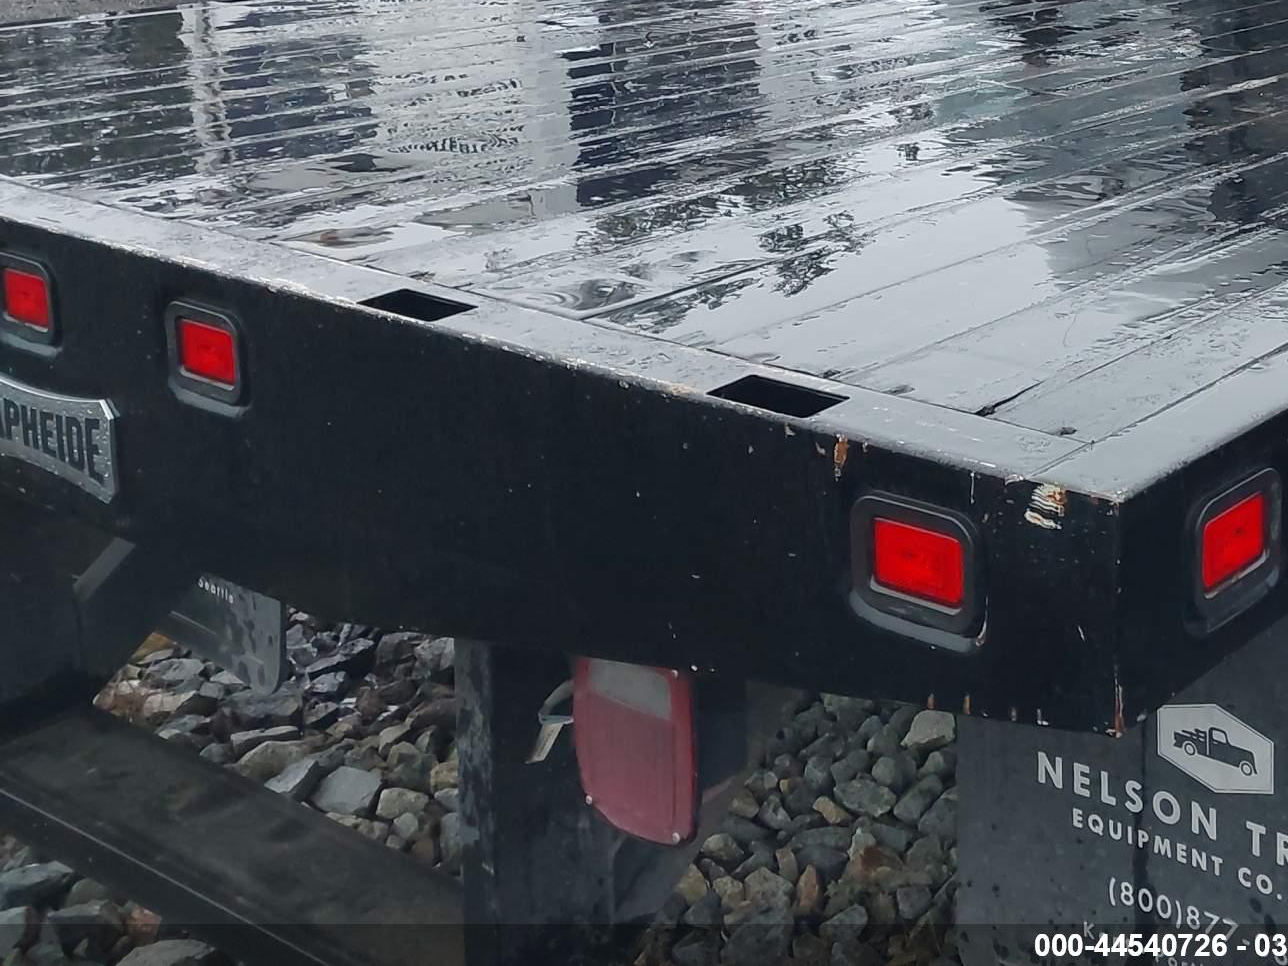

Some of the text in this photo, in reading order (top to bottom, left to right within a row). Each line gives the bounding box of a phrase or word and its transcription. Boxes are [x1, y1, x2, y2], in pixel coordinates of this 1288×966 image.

[0, 398, 105, 485] PHEIDE
[1037, 752, 1218, 841] NELSON
[1072, 808, 1224, 876] EQUIPMENT
